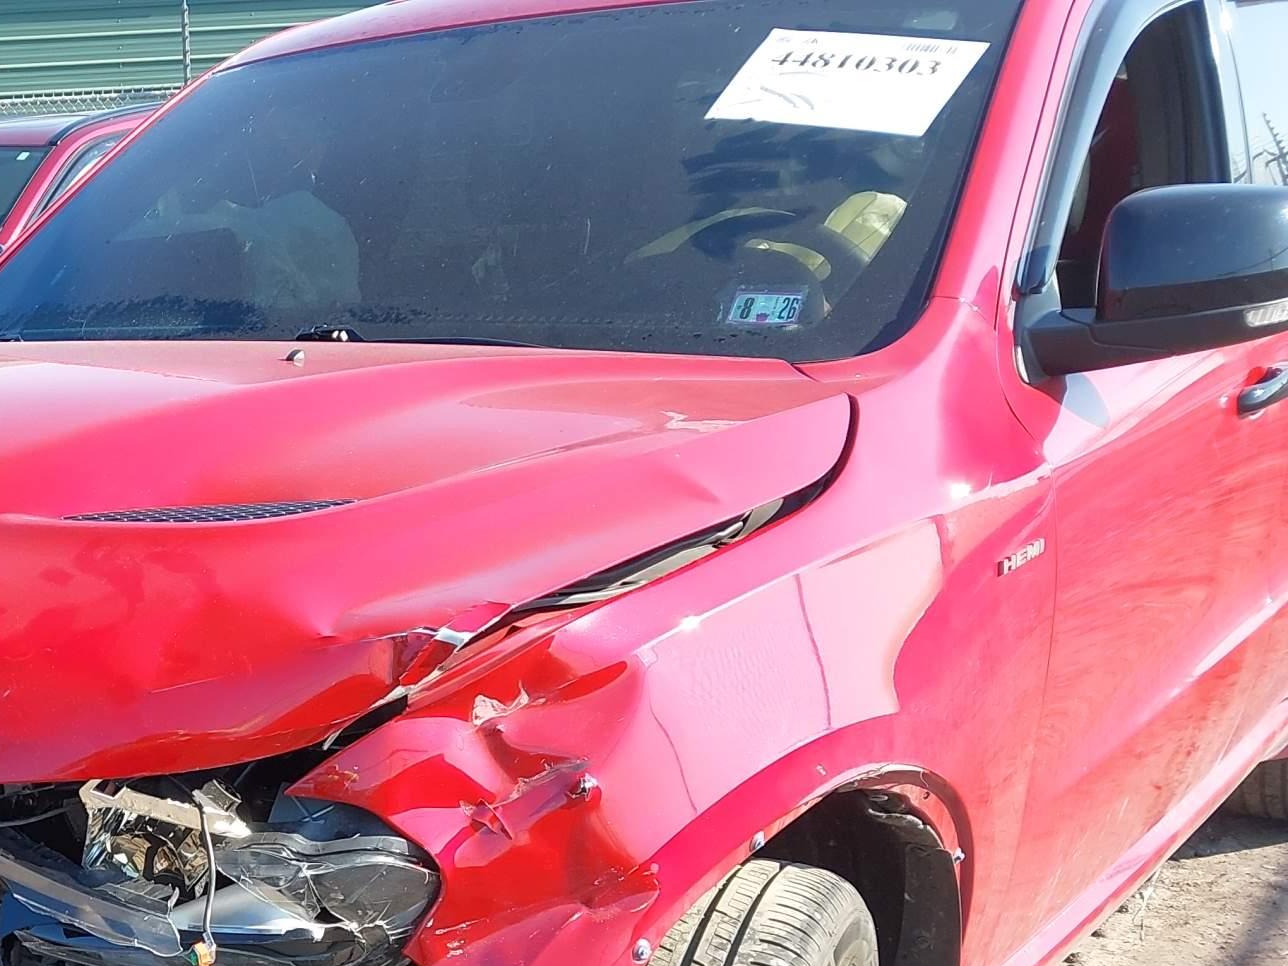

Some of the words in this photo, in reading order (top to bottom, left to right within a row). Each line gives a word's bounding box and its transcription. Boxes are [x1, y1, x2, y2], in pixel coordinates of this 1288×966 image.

[770, 50, 943, 76] 44810303
[777, 297, 800, 320] 26
[999, 537, 1046, 576] HEMI
